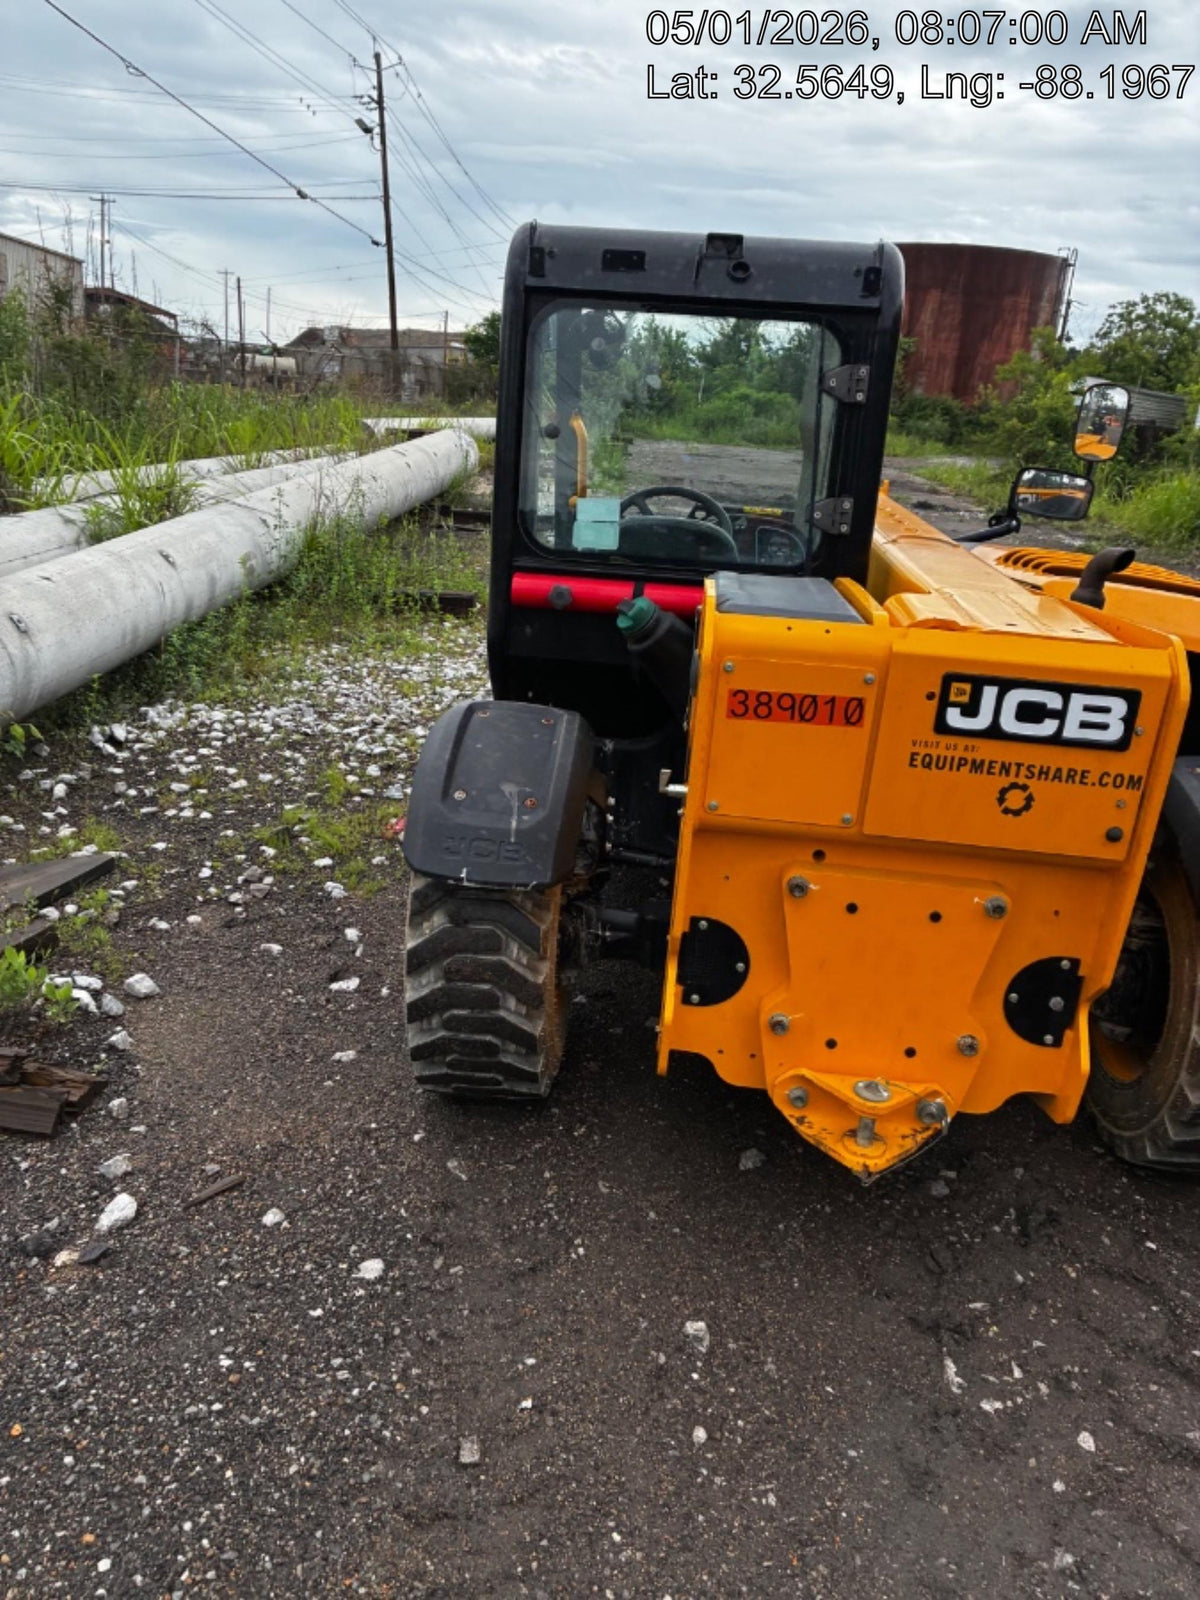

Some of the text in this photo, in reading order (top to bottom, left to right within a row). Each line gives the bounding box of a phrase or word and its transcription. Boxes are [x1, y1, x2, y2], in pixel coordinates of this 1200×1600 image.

[730, 689, 865, 726] 389010
[945, 685, 1129, 742] JCB
[911, 739, 940, 748] VISIT
[946, 743, 958, 751] US
[908, 752, 1144, 792] EQUIPMENTSHARE.COM
